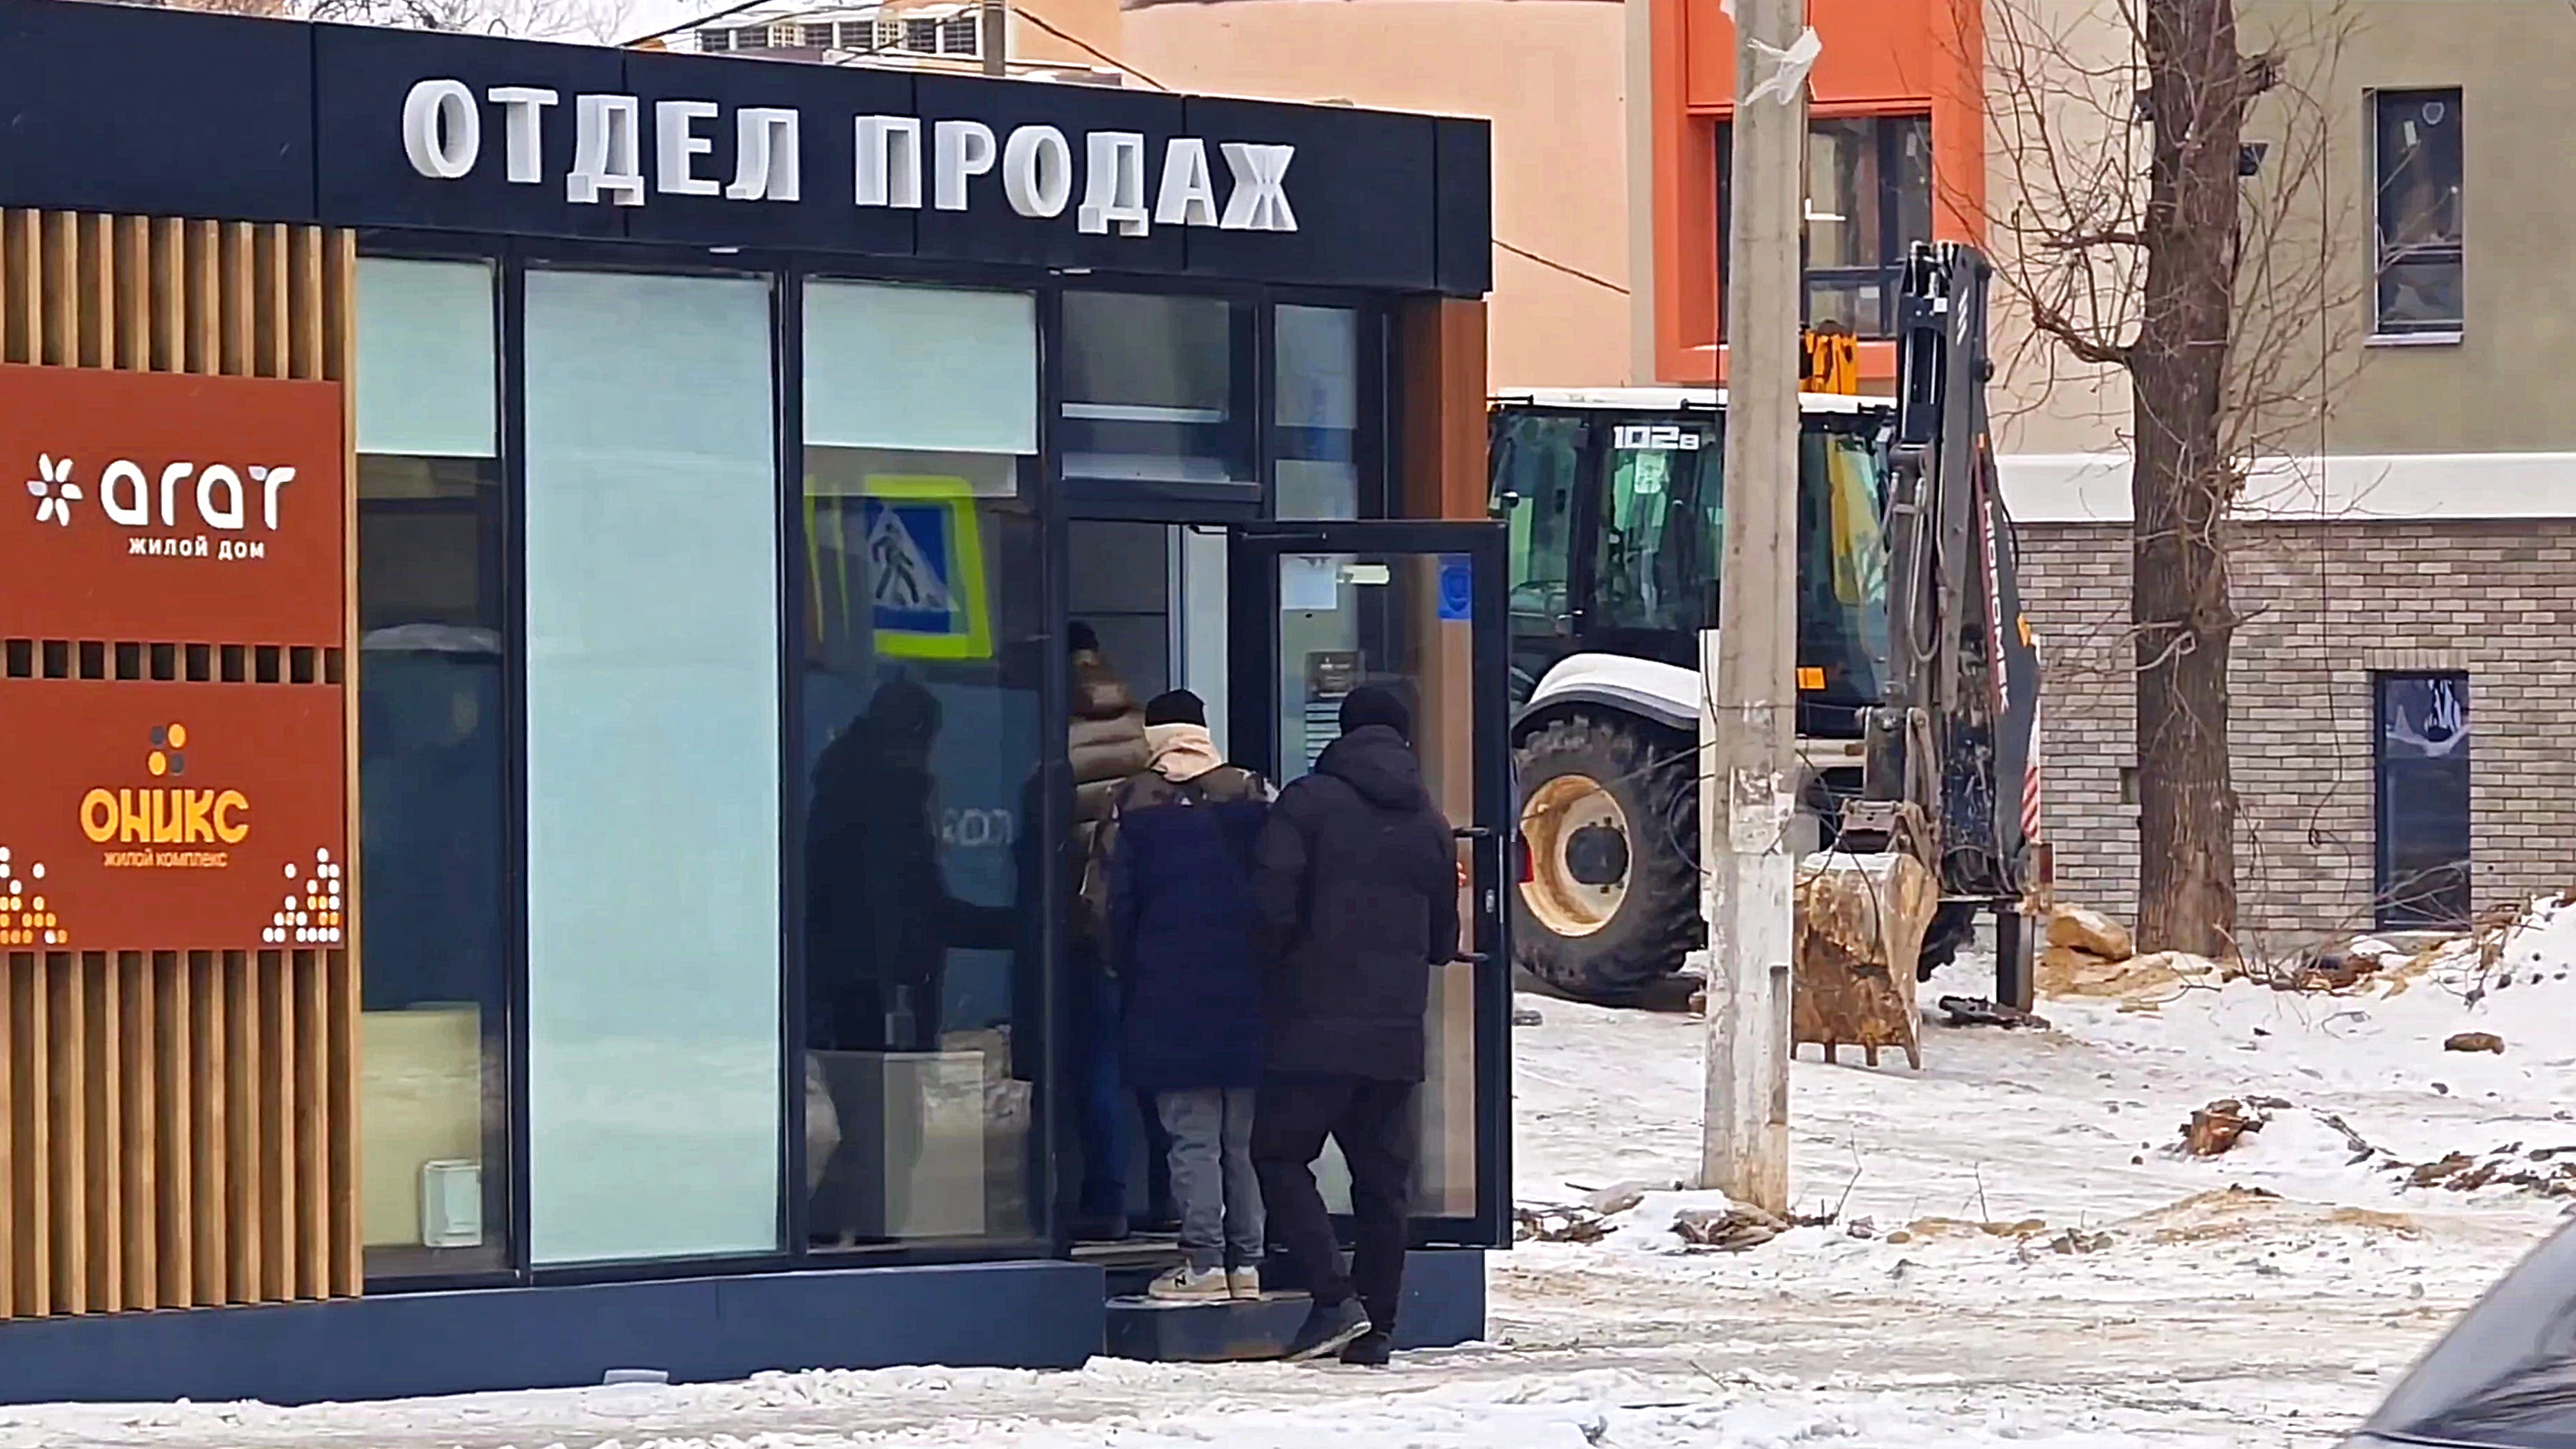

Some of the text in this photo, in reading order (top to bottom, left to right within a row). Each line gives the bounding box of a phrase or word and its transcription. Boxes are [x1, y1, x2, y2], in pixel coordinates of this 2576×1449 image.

[403, 78, 1298, 237] ОТДЕЛ ПРОДАЖ
[128, 535, 264, 561] ЖИЛОЙ ДОМ
[80, 788, 250, 844] ОНИКС
[156, 852, 228, 867] КОМПЛЕКС
